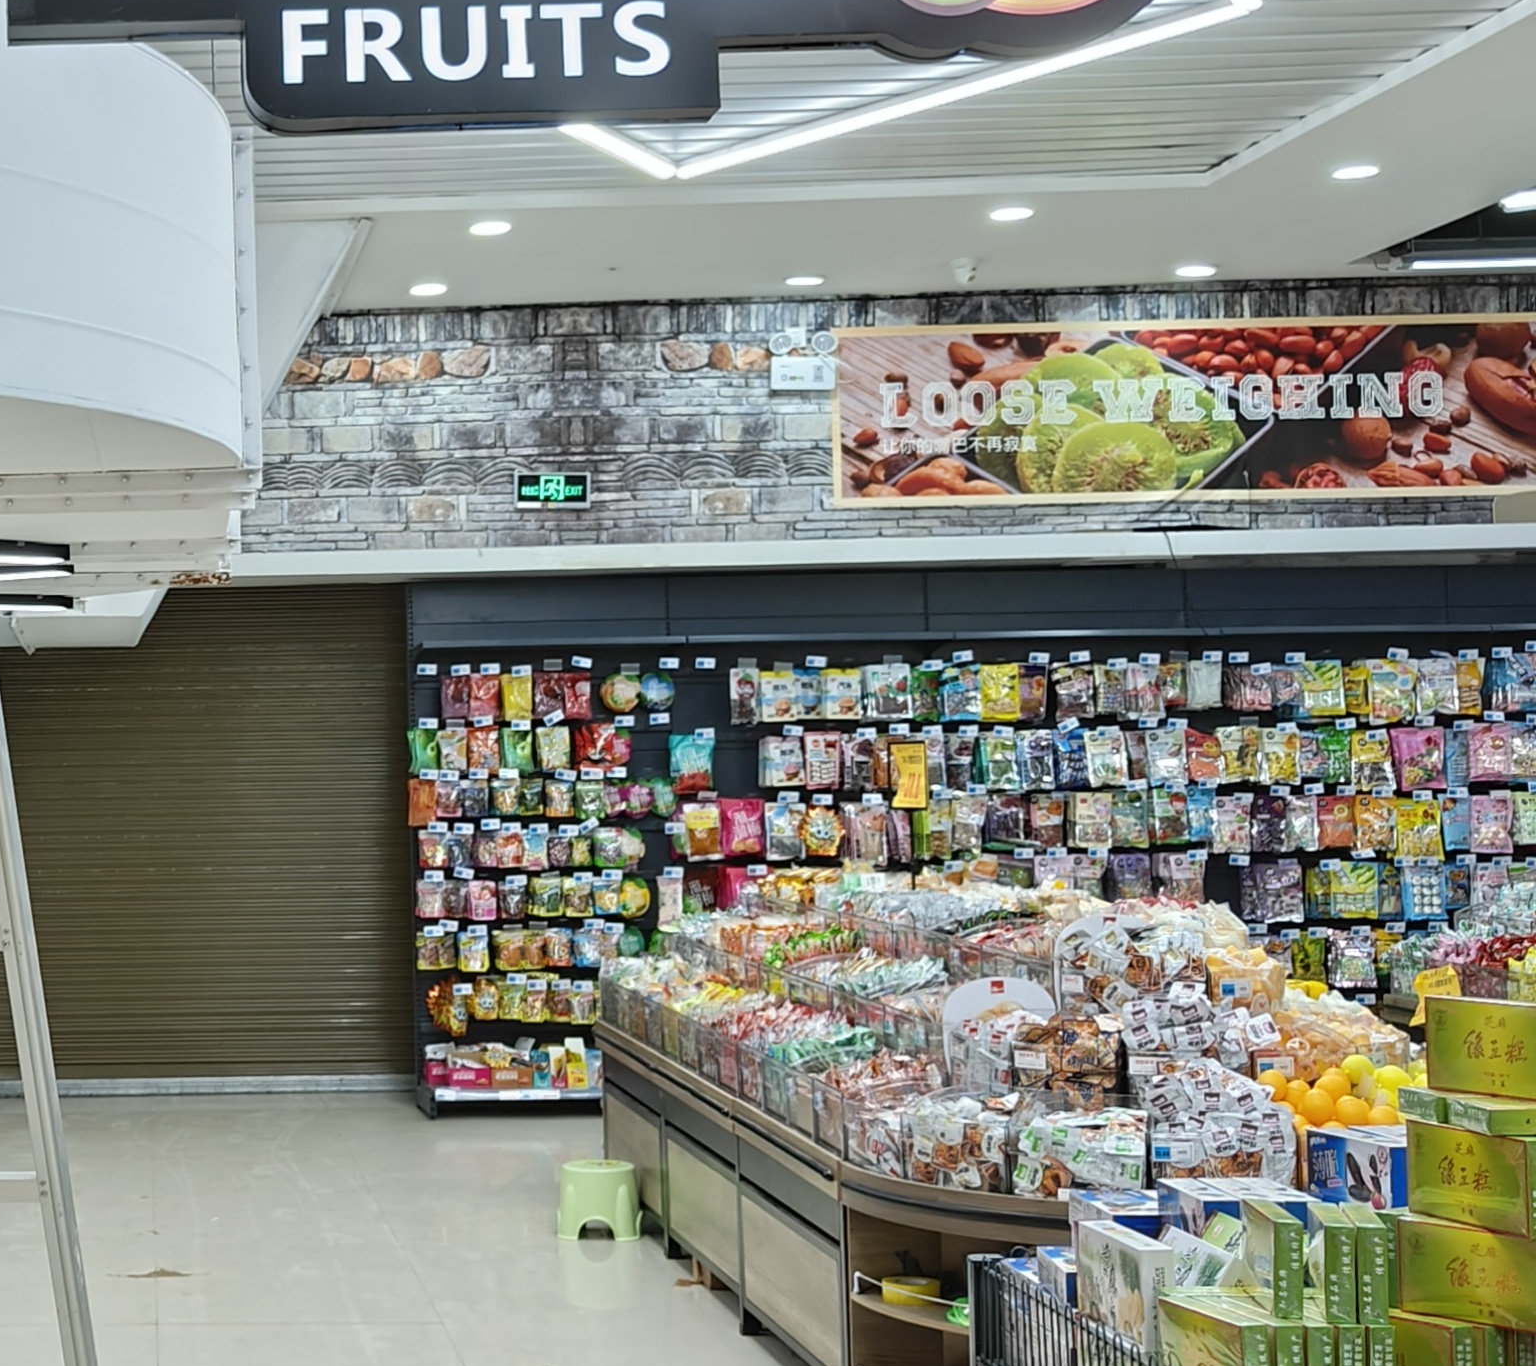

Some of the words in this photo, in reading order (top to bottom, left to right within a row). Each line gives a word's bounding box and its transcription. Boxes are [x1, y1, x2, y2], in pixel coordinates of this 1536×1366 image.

[283, 0, 671, 83] FRUITS
[879, 377, 1077, 429] LOOSE
[1093, 371, 1444, 422] WEIGHING
